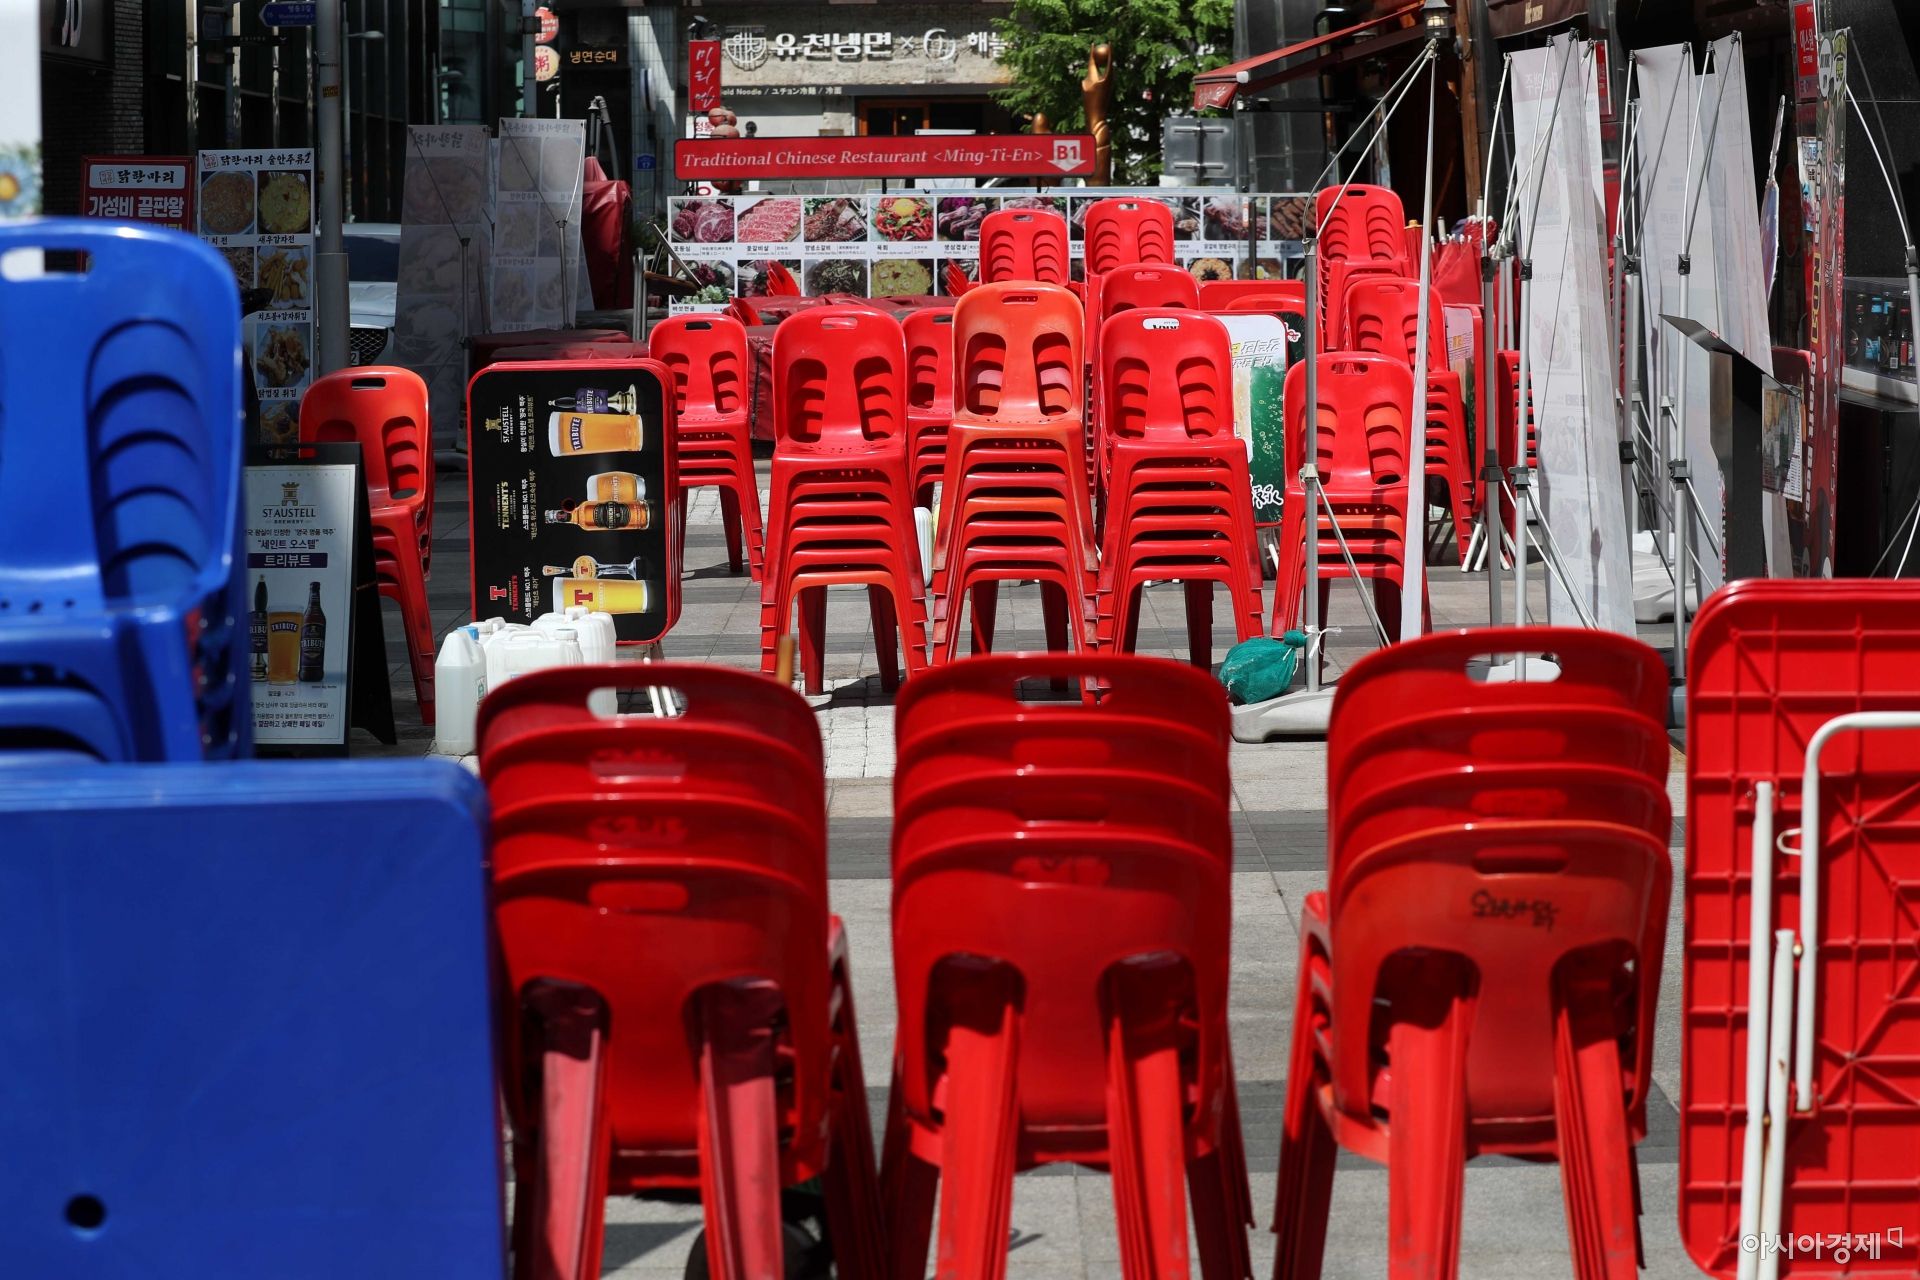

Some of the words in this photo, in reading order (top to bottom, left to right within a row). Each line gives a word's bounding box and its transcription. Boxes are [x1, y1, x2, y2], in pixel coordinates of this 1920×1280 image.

[770, 32, 893, 57] 유천냉면
[721, 88, 735, 96] old
[736, 88, 763, 96] Noodle
[220, 154, 263, 166] 닭한마리
[684, 151, 771, 167] Traditional
[775, 150, 836, 165] Chinese
[840, 149, 928, 164] Restaurant
[933, 148, 1043, 165] <Ming-Ti-En>
[1056, 144, 1079, 160] B1
[117, 169, 175, 184] 닭한마리
[88, 195, 134, 218] 가성비
[138, 196, 185, 218] 끝판왕
[351, 353, 357, 364] 2
[501, 405, 510, 436] AUSTELL
[571, 418, 582, 450] TRIBUTE
[521, 478, 528, 490] 맥주
[273, 508, 316, 518] AUSTELL
[501, 481, 510, 530] TENNENT'S
[264, 554, 311, 567] 트리뷰트
[524, 566, 531, 578] 맥주
[489, 585, 507, 601] T
[574, 589, 594, 606] T
[524, 591, 532, 618] 스코틀랜드
[272, 622, 297, 631] TRIBUTE
